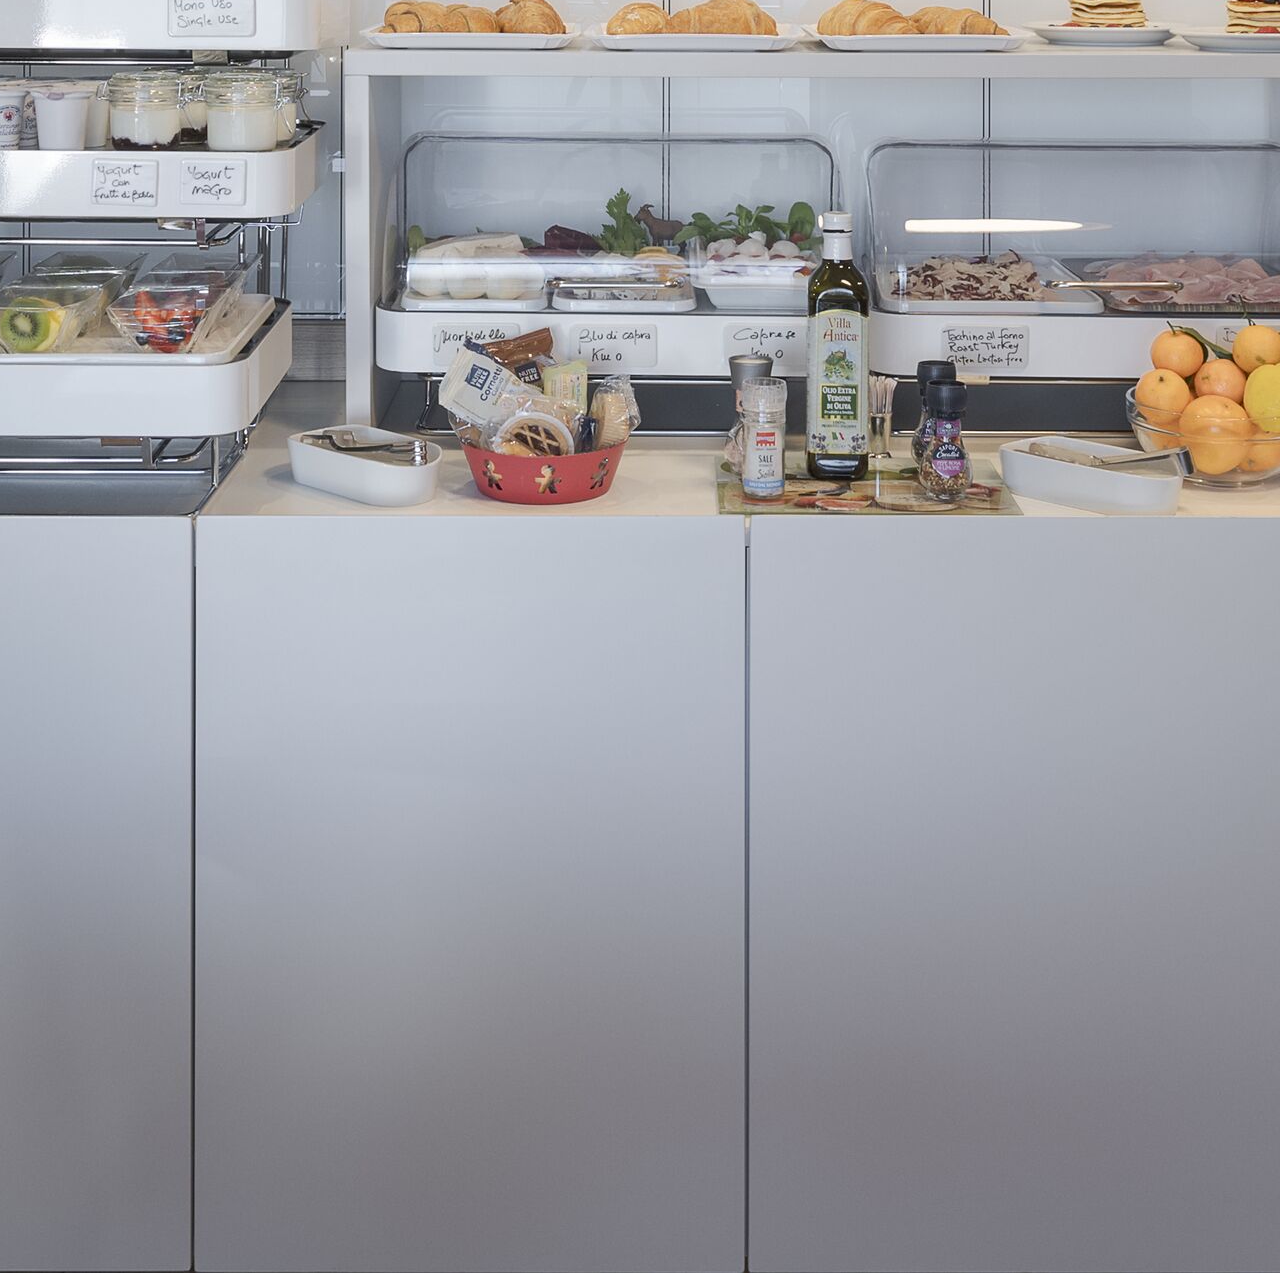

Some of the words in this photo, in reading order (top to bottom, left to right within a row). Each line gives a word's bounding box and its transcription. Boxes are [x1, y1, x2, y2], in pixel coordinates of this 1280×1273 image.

[827, 317, 851, 329] Villa
[823, 329, 857, 342] Antica
[519, 367, 537, 377] NUTRI
